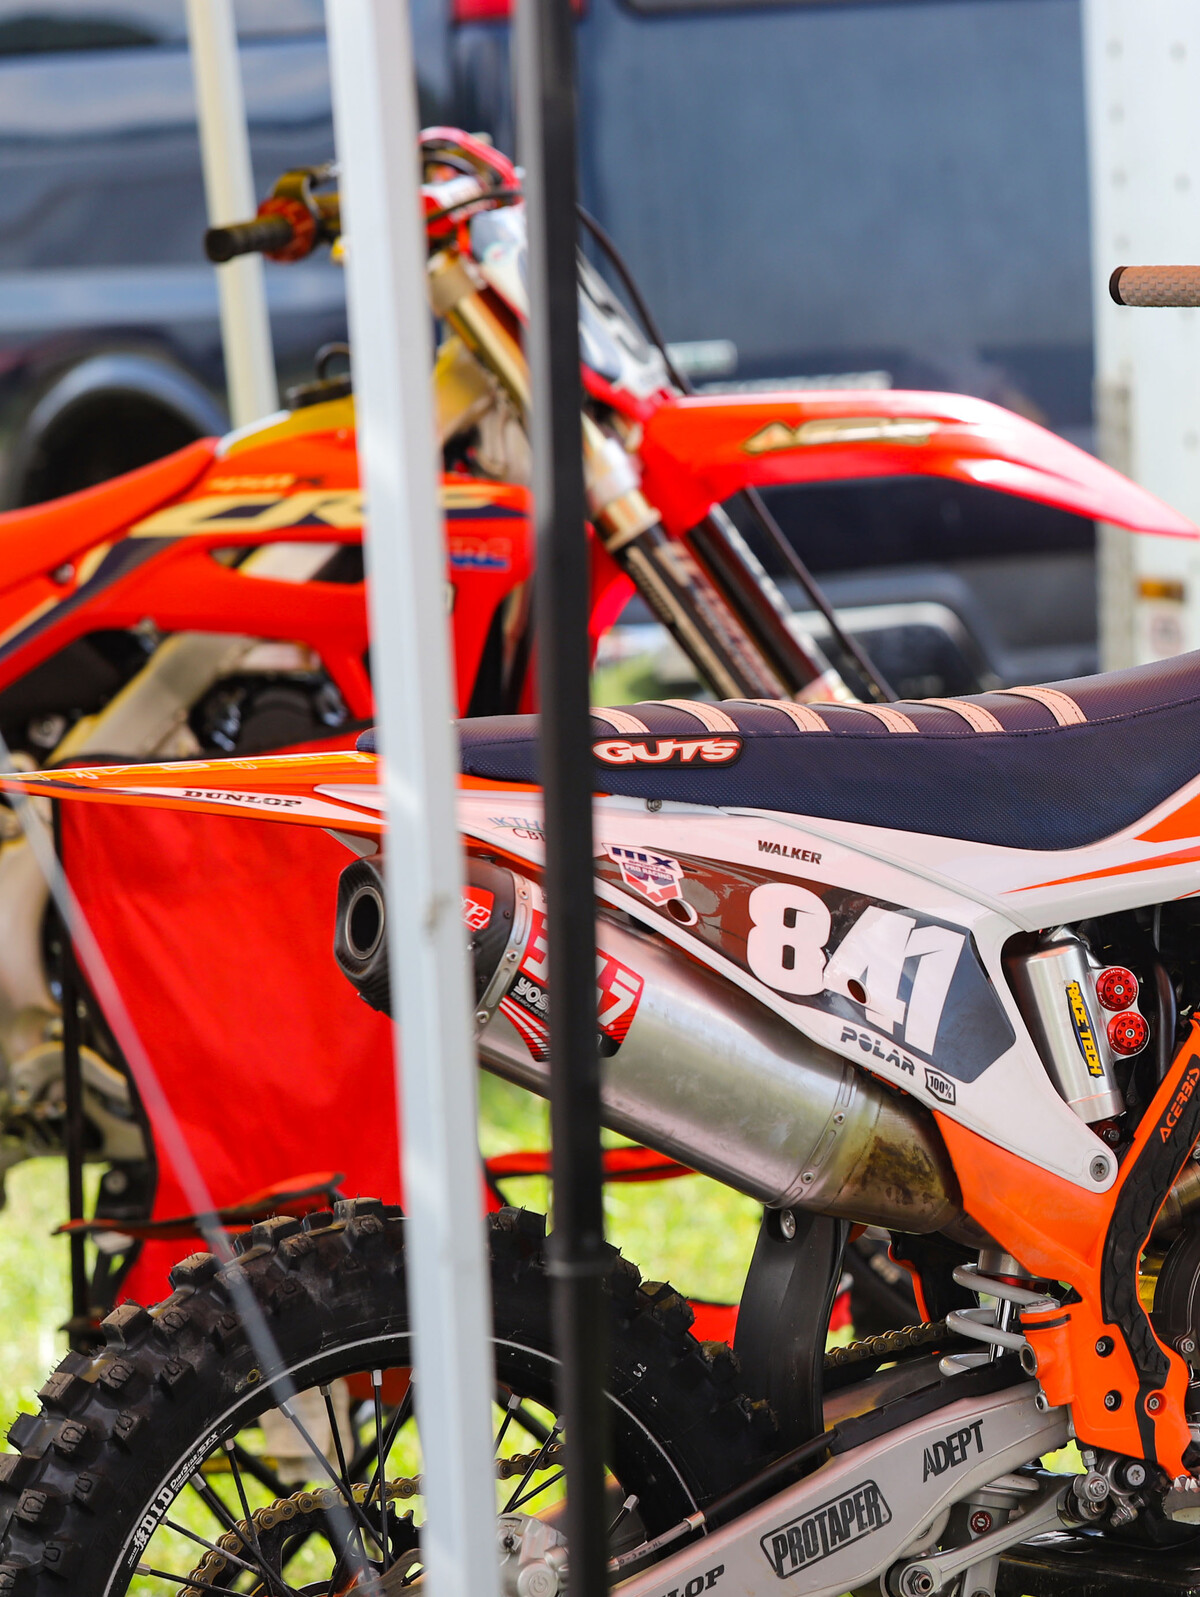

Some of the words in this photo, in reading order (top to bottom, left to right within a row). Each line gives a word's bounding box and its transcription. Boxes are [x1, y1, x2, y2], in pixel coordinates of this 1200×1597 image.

[592, 737, 742, 765] GUTS
[183, 790, 303, 808] DUNLOP
[757, 840, 823, 865] WALKER
[746, 882, 967, 1056] 841
[840, 1026, 916, 1076] POLAR
[928, 1075, 953, 1099] 100%
[1160, 1067, 1200, 1143] ACERBIS
[923, 1418, 984, 1484] ADEPT
[771, 1485, 885, 1580] PROTAPER
